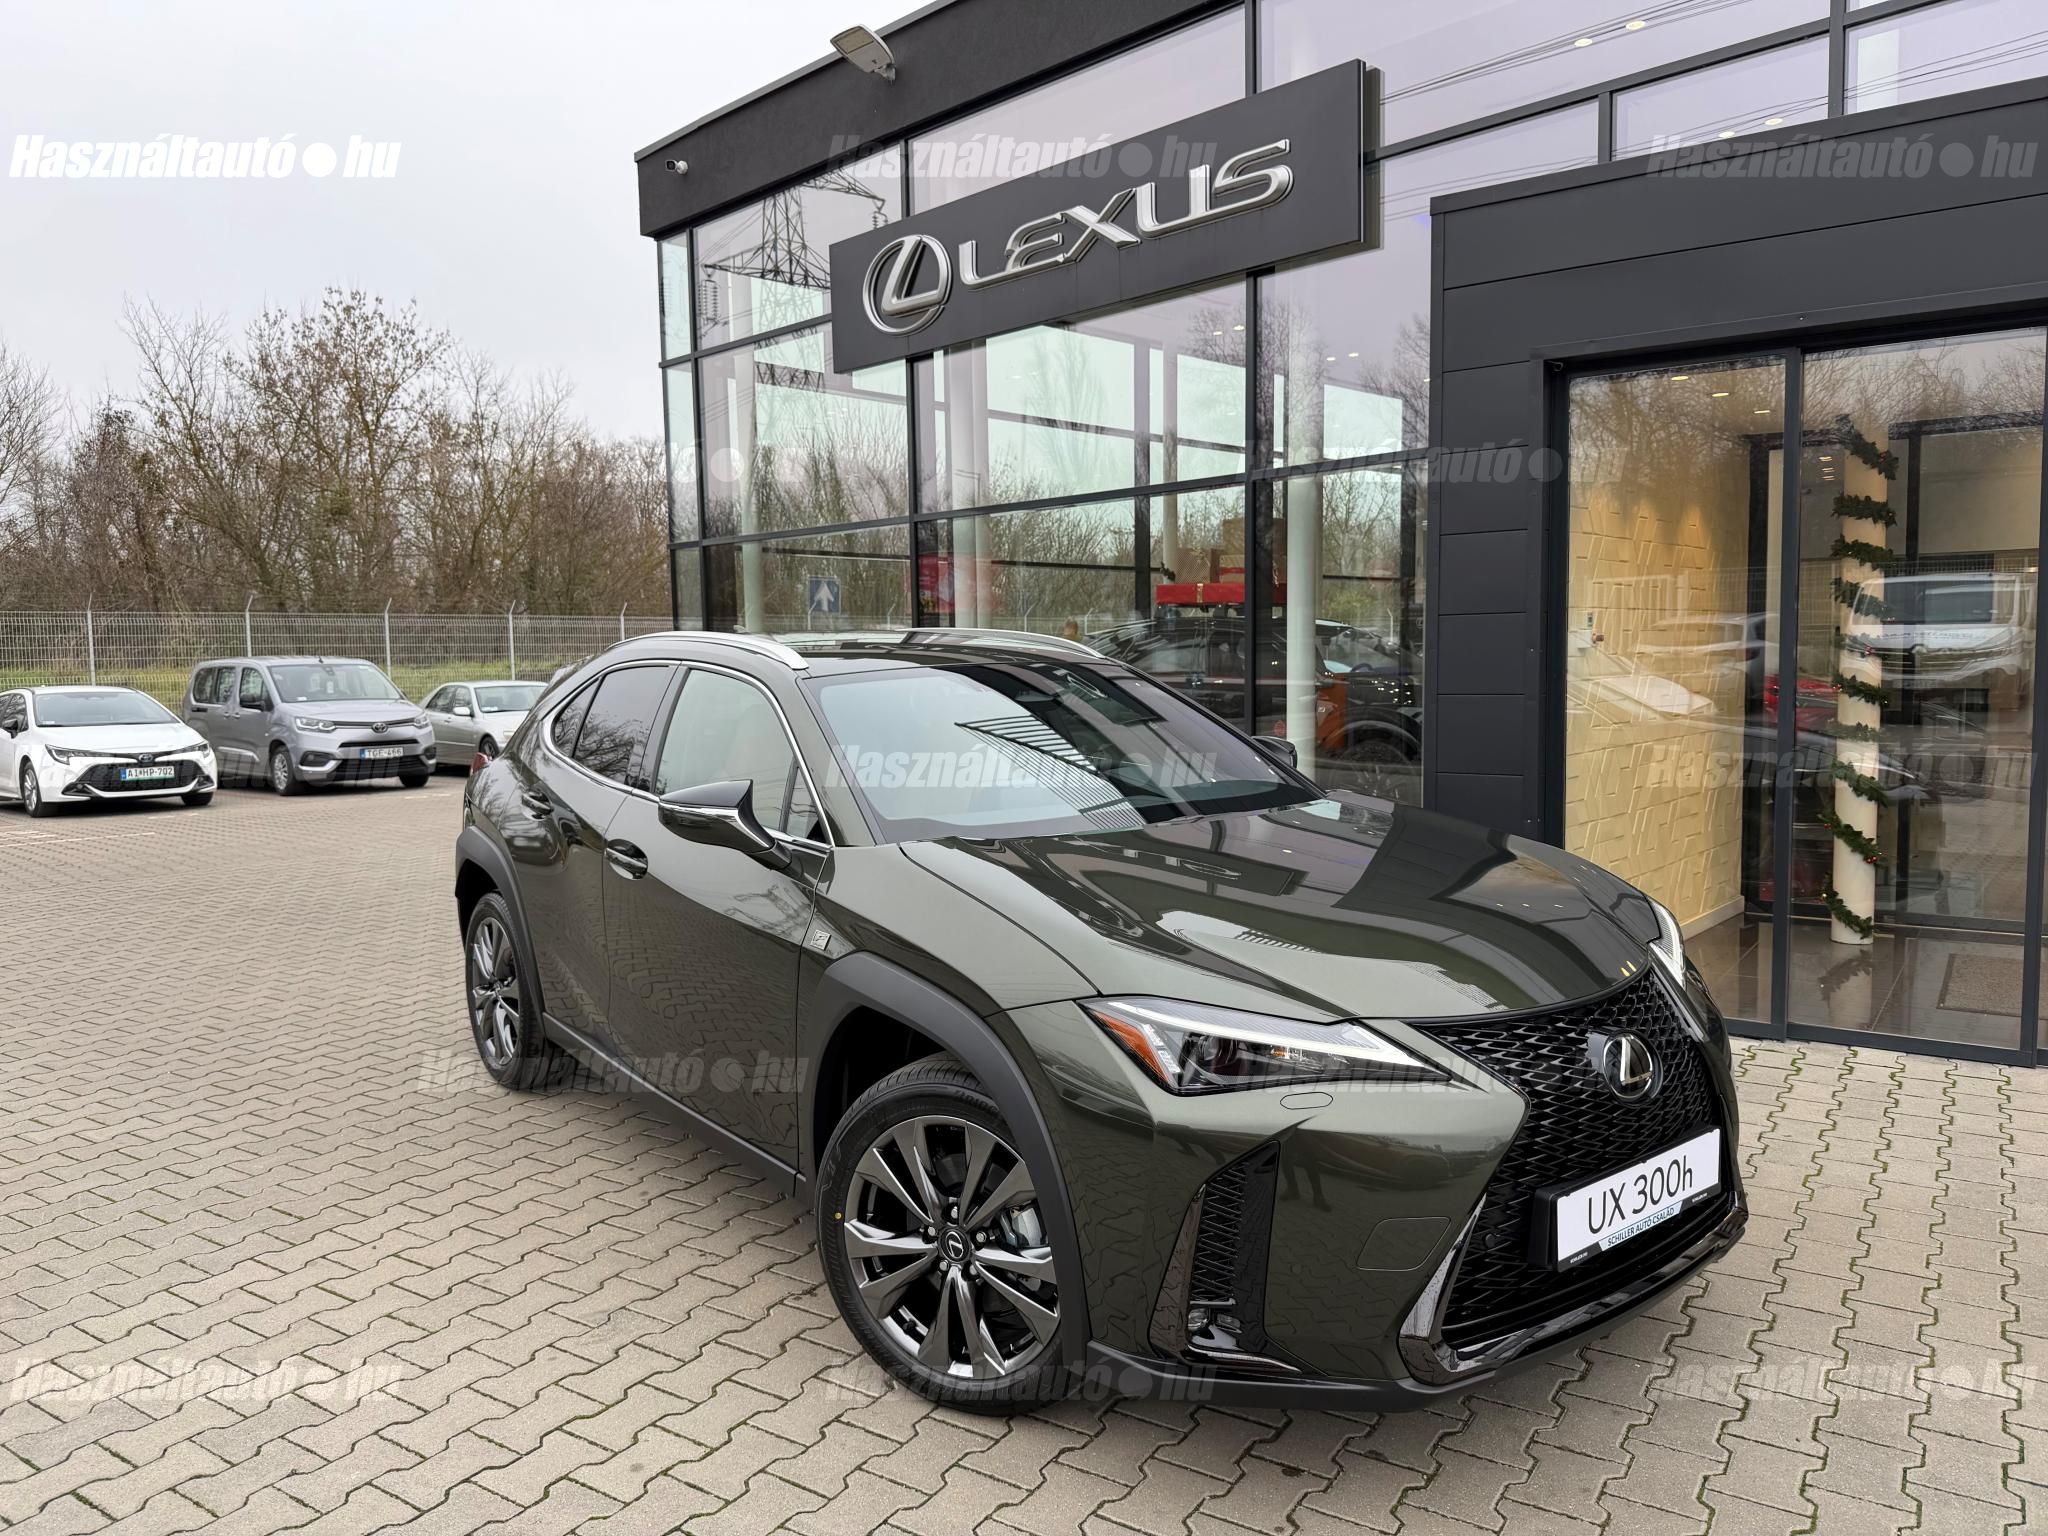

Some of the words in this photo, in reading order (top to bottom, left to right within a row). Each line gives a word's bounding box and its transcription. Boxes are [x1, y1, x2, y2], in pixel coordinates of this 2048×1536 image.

[958, 138, 1294, 290] LEXUS
[1588, 1181, 1627, 1235] UX
[1632, 1155, 1694, 1215] 300h
[1607, 1225, 1635, 1247] SCHILLER
[1635, 1216, 1652, 1235] AUTÓ
[1652, 1206, 1675, 1226] CSALÁD
